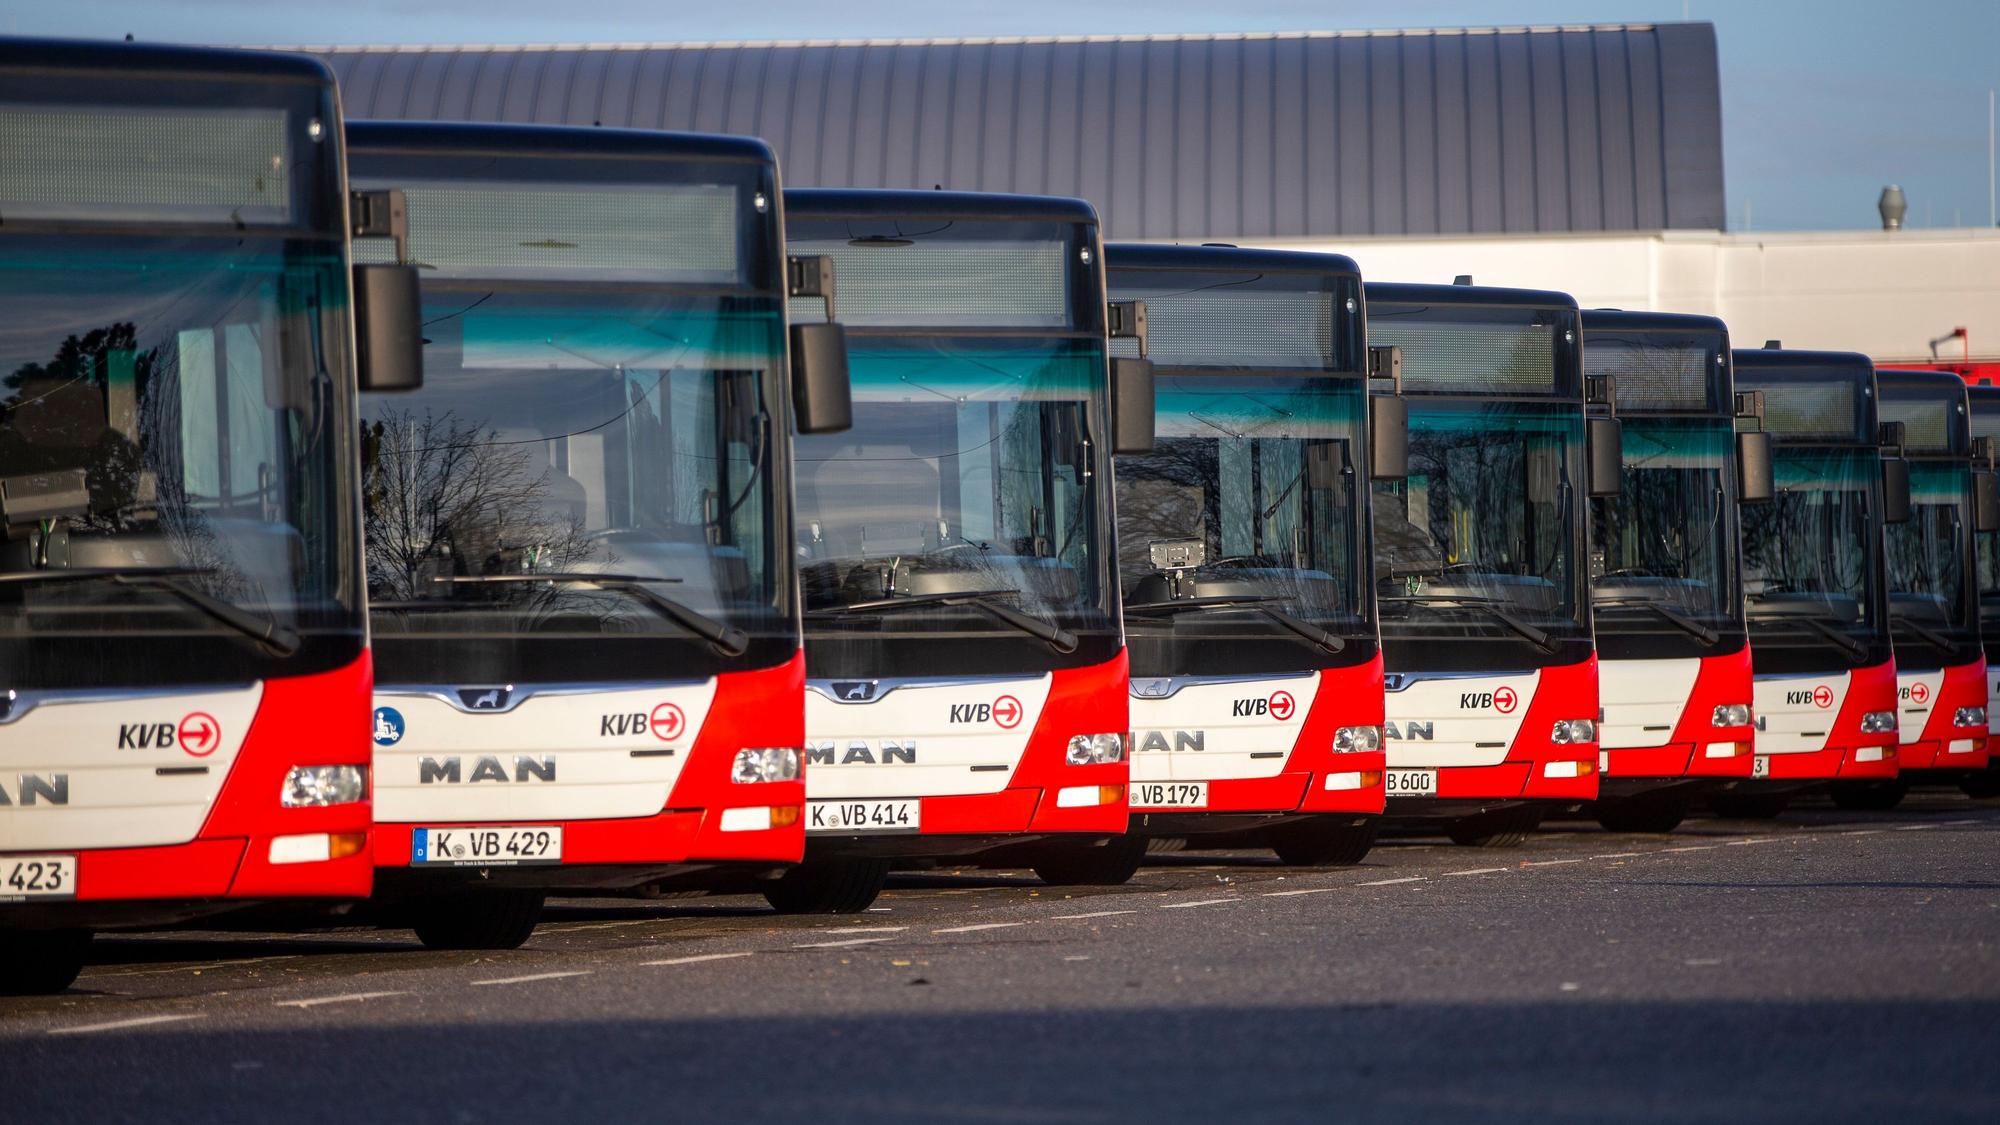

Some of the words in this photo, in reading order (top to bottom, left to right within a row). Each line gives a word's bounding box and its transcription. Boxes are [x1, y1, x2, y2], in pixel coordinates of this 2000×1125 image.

[1232, 699, 1267, 717] KVB
[1460, 693, 1492, 709] KVB
[1786, 691, 1813, 705] KVB
[950, 703, 990, 723] KVB
[600, 713, 647, 736] KVB
[118, 723, 175, 749] KVB
[1129, 730, 1205, 752] AN
[806, 740, 916, 765] MAN
[418, 755, 556, 784] MAN
[1400, 773, 1429, 790] 600
[1142, 785, 1163, 804] VB
[1168, 785, 1199, 804] 179
[812, 805, 825, 826] K
[841, 804, 866, 825] VB
[871, 804, 909, 825] 414
[436, 832, 452, 857] K
[470, 832, 500, 856] VB
[506, 831, 550, 855] 429
[9, 862, 62, 890] 423
